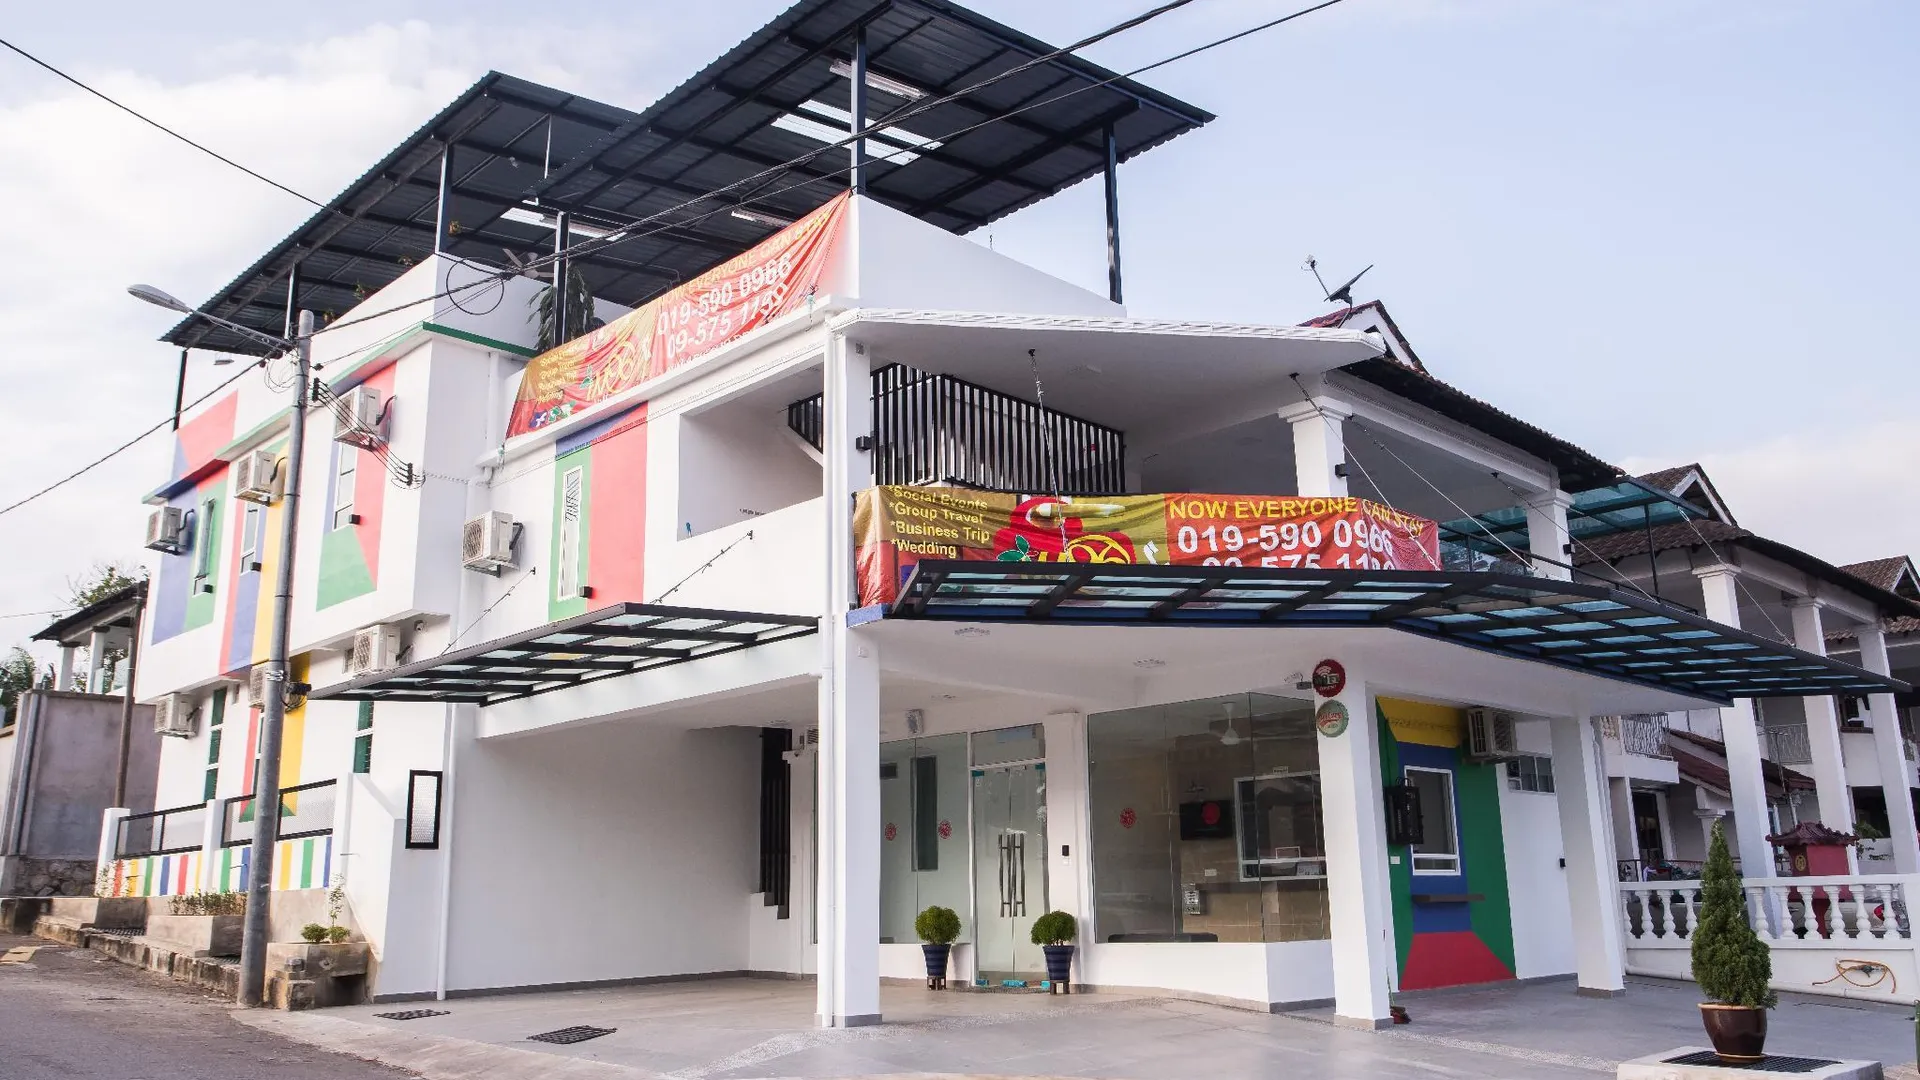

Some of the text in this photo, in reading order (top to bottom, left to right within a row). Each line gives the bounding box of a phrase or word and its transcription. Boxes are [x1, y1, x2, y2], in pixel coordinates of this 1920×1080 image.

[657, 252, 792, 335] 019-590 0966
[666, 309, 732, 359] 09-575
[941, 508, 983, 524] Travel
[963, 527, 990, 543] Trip
[1169, 497, 1424, 537] NOW EVERYONE CAN STAY
[1177, 519, 1394, 557] 019-590 0966
